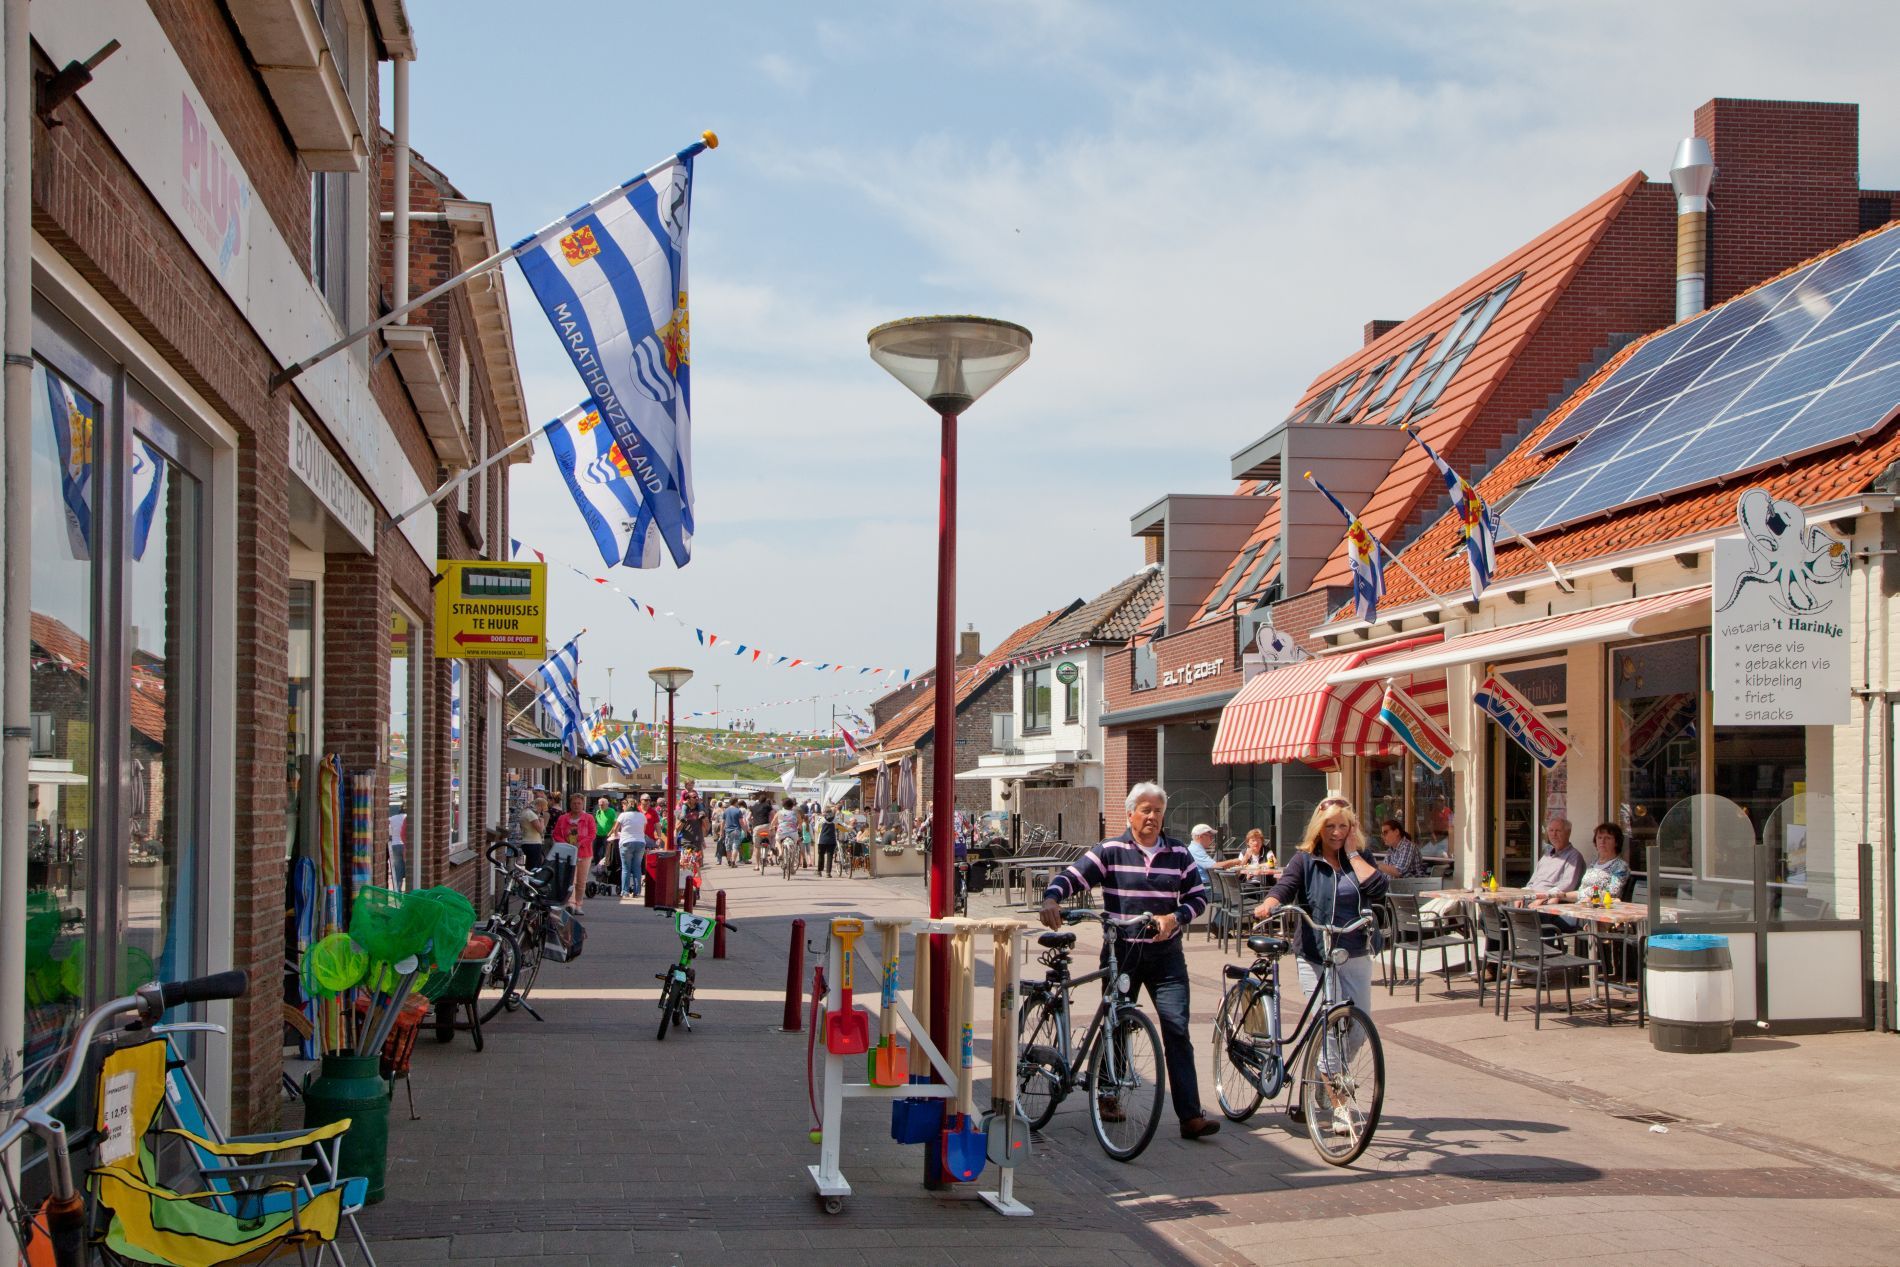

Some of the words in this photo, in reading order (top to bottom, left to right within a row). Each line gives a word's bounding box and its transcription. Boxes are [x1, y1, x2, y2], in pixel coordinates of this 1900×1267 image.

[182, 90, 242, 256] PLUS
[554, 303, 663, 494] MARATHONZEELAND
[296, 419, 368, 537] BOUWBEDRIJF
[452, 603, 539, 616] STRANDHUISJES
[473, 618, 485, 629] TE
[488, 619, 519, 630] HUUR
[1722, 620, 1770, 637] vistaria
[1788, 618, 1843, 638] Harinkje
[1745, 643, 1782, 653] verse
[1786, 641, 1805, 653] vis
[1745, 657, 1807, 672] gebakken
[1811, 658, 1831, 669] vis
[1745, 674, 1802, 690] kibbeling
[1745, 690, 1776, 704] friet
[1487, 681, 1558, 760] VIS
[1745, 707, 1794, 720] snacks
[111, 1105, 128, 1119] 12,95
